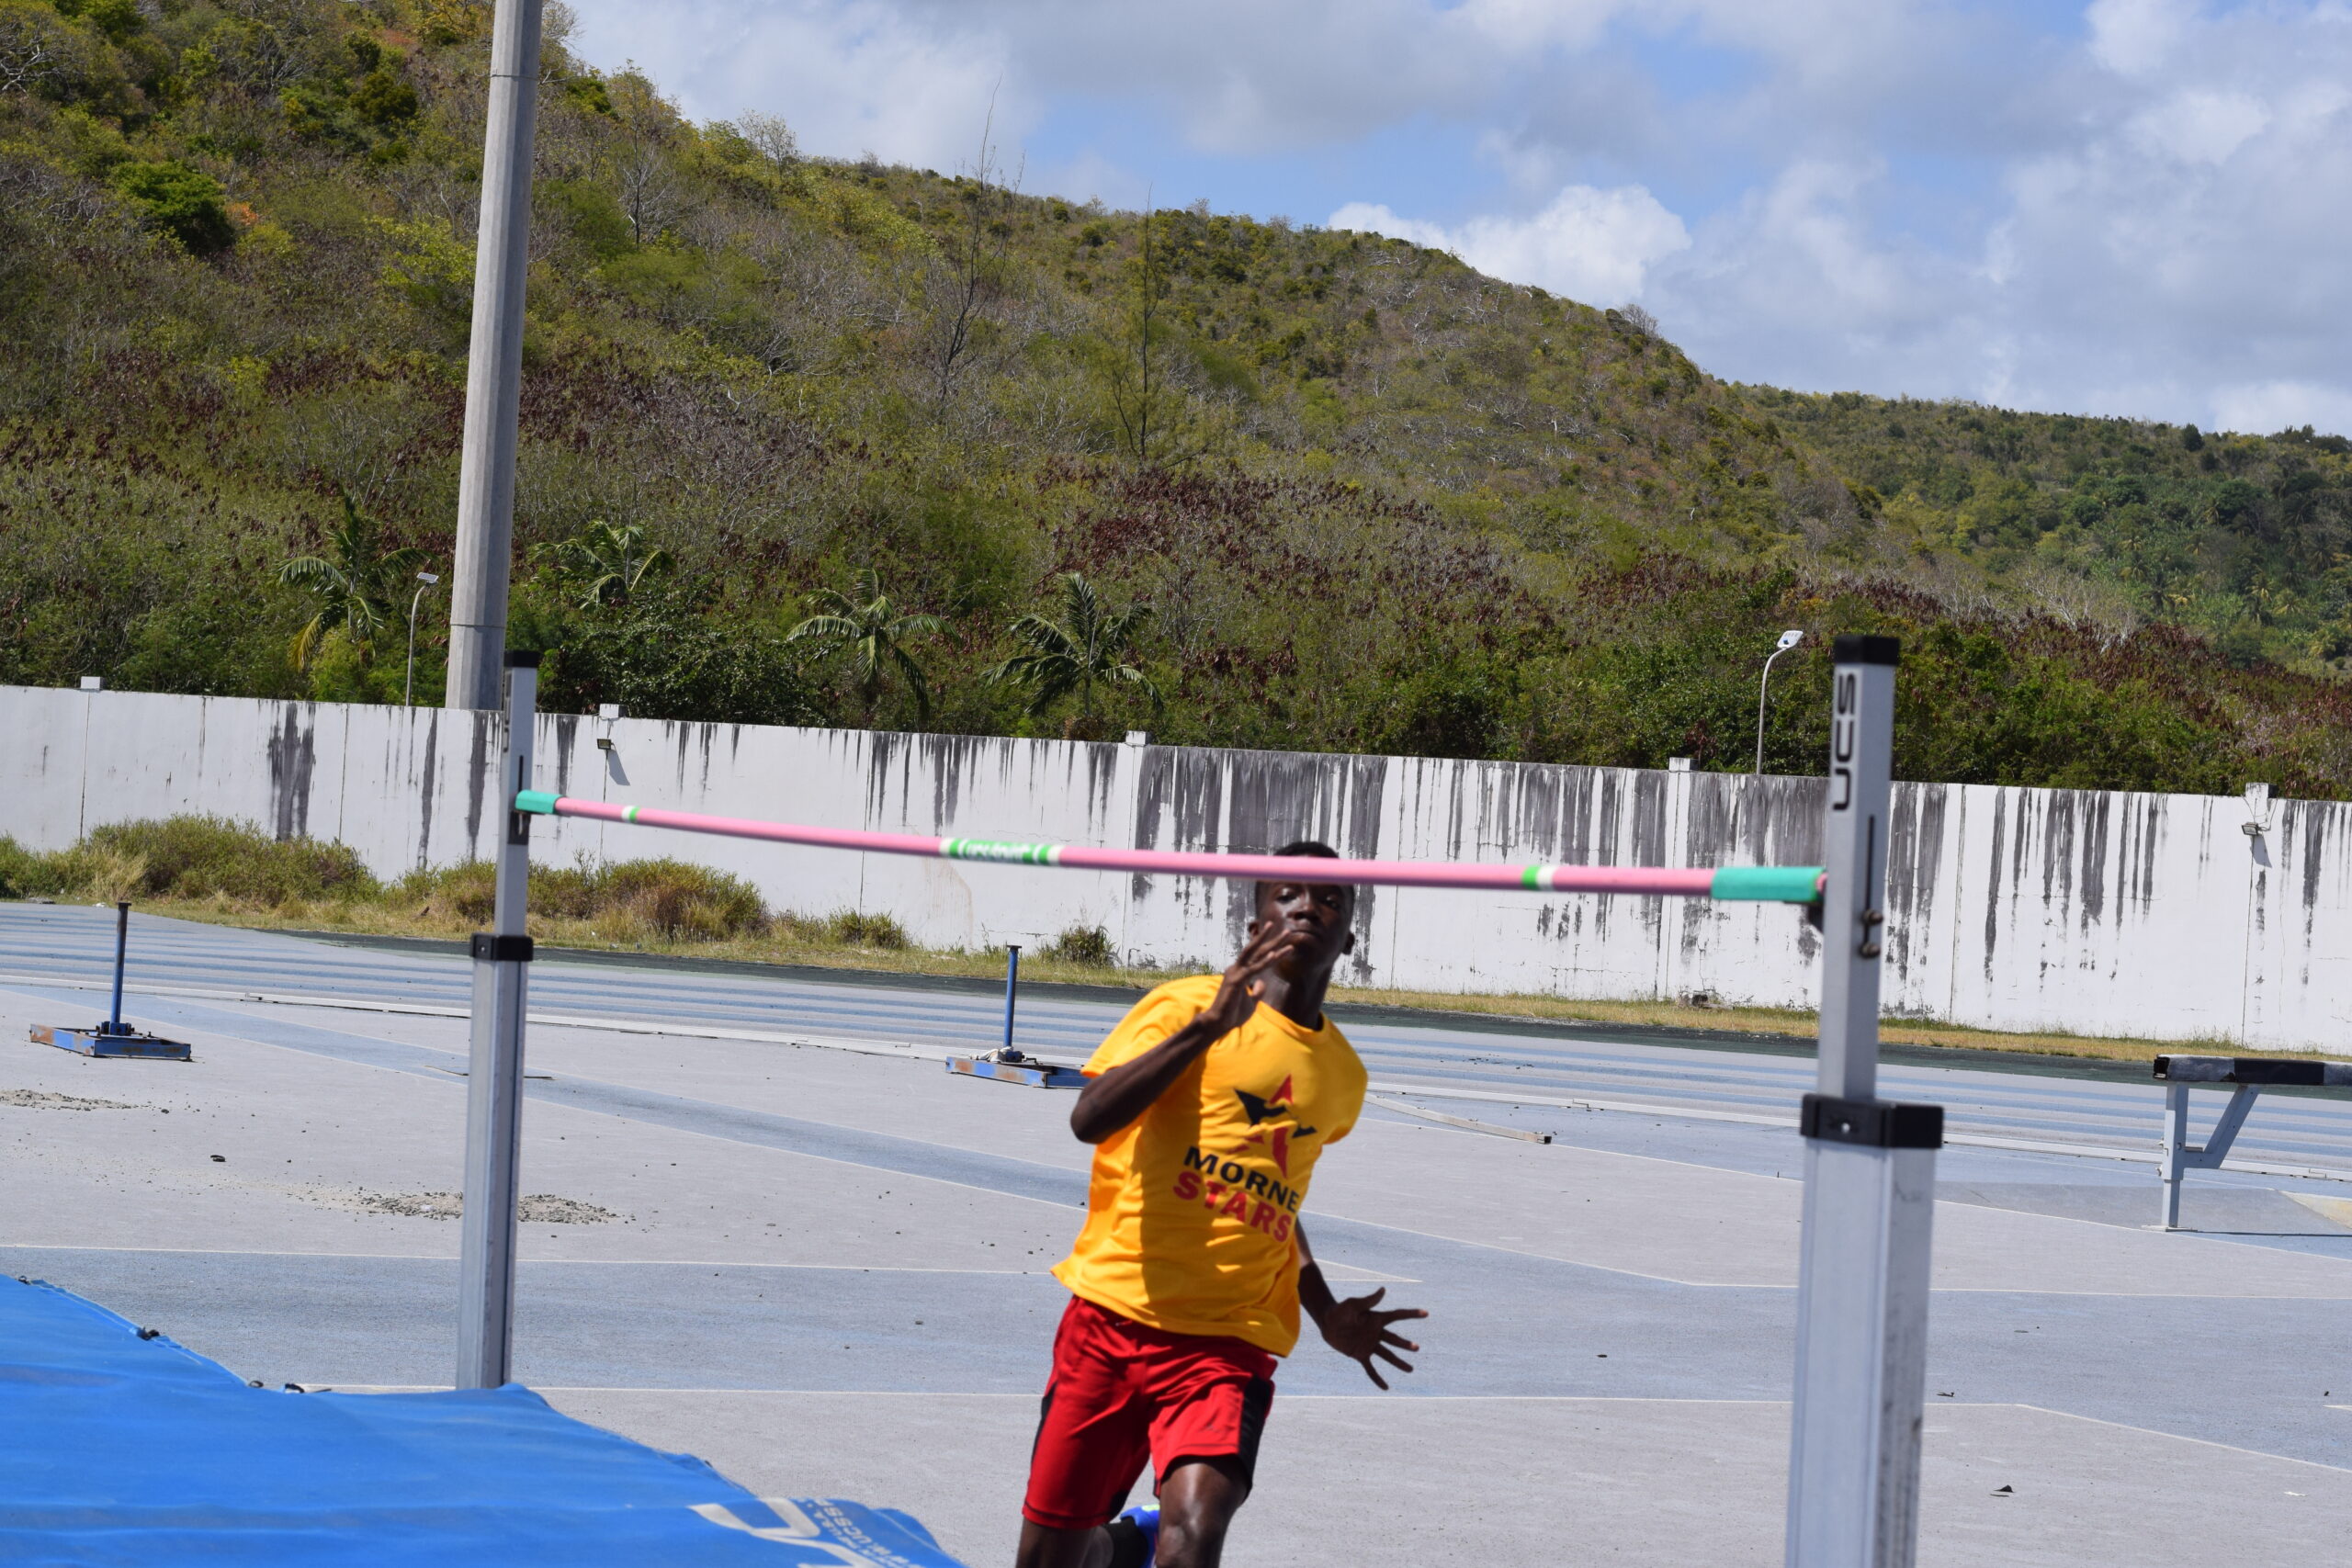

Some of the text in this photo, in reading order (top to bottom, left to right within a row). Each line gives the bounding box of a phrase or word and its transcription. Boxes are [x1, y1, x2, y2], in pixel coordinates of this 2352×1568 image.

[1833, 673, 1856, 811] UCS
[1173, 1171, 1292, 1243] STARS
[1183, 1146, 1299, 1213] MORNE
